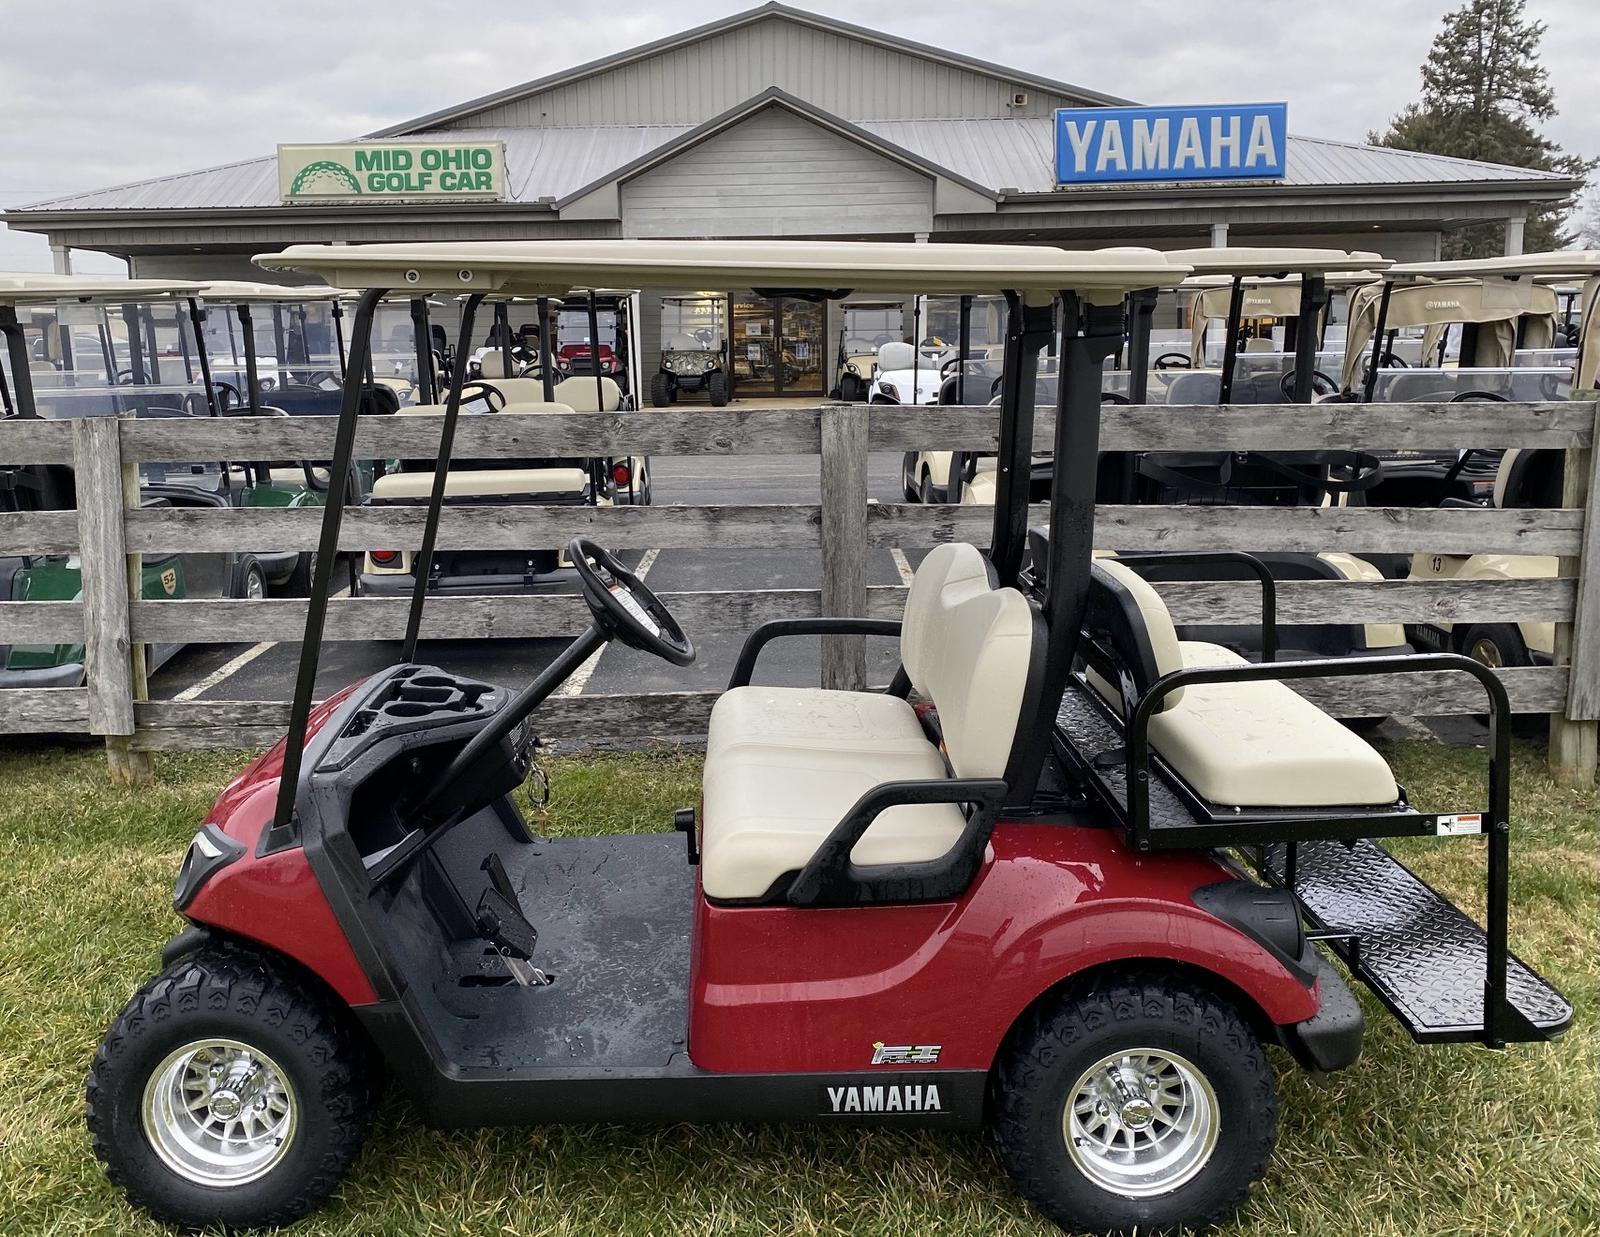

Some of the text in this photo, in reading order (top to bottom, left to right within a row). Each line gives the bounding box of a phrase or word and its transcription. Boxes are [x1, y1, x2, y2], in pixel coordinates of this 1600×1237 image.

[1064, 115, 1278, 173] YAMAHA
[355, 149, 493, 172] MID OHIO
[367, 171, 493, 192] GOLF CAR
[1433, 300, 1461, 309] YAMAHA
[1432, 556, 1442, 571] 13
[163, 573, 175, 584] 52
[827, 1084, 942, 1113] YAMAHA
